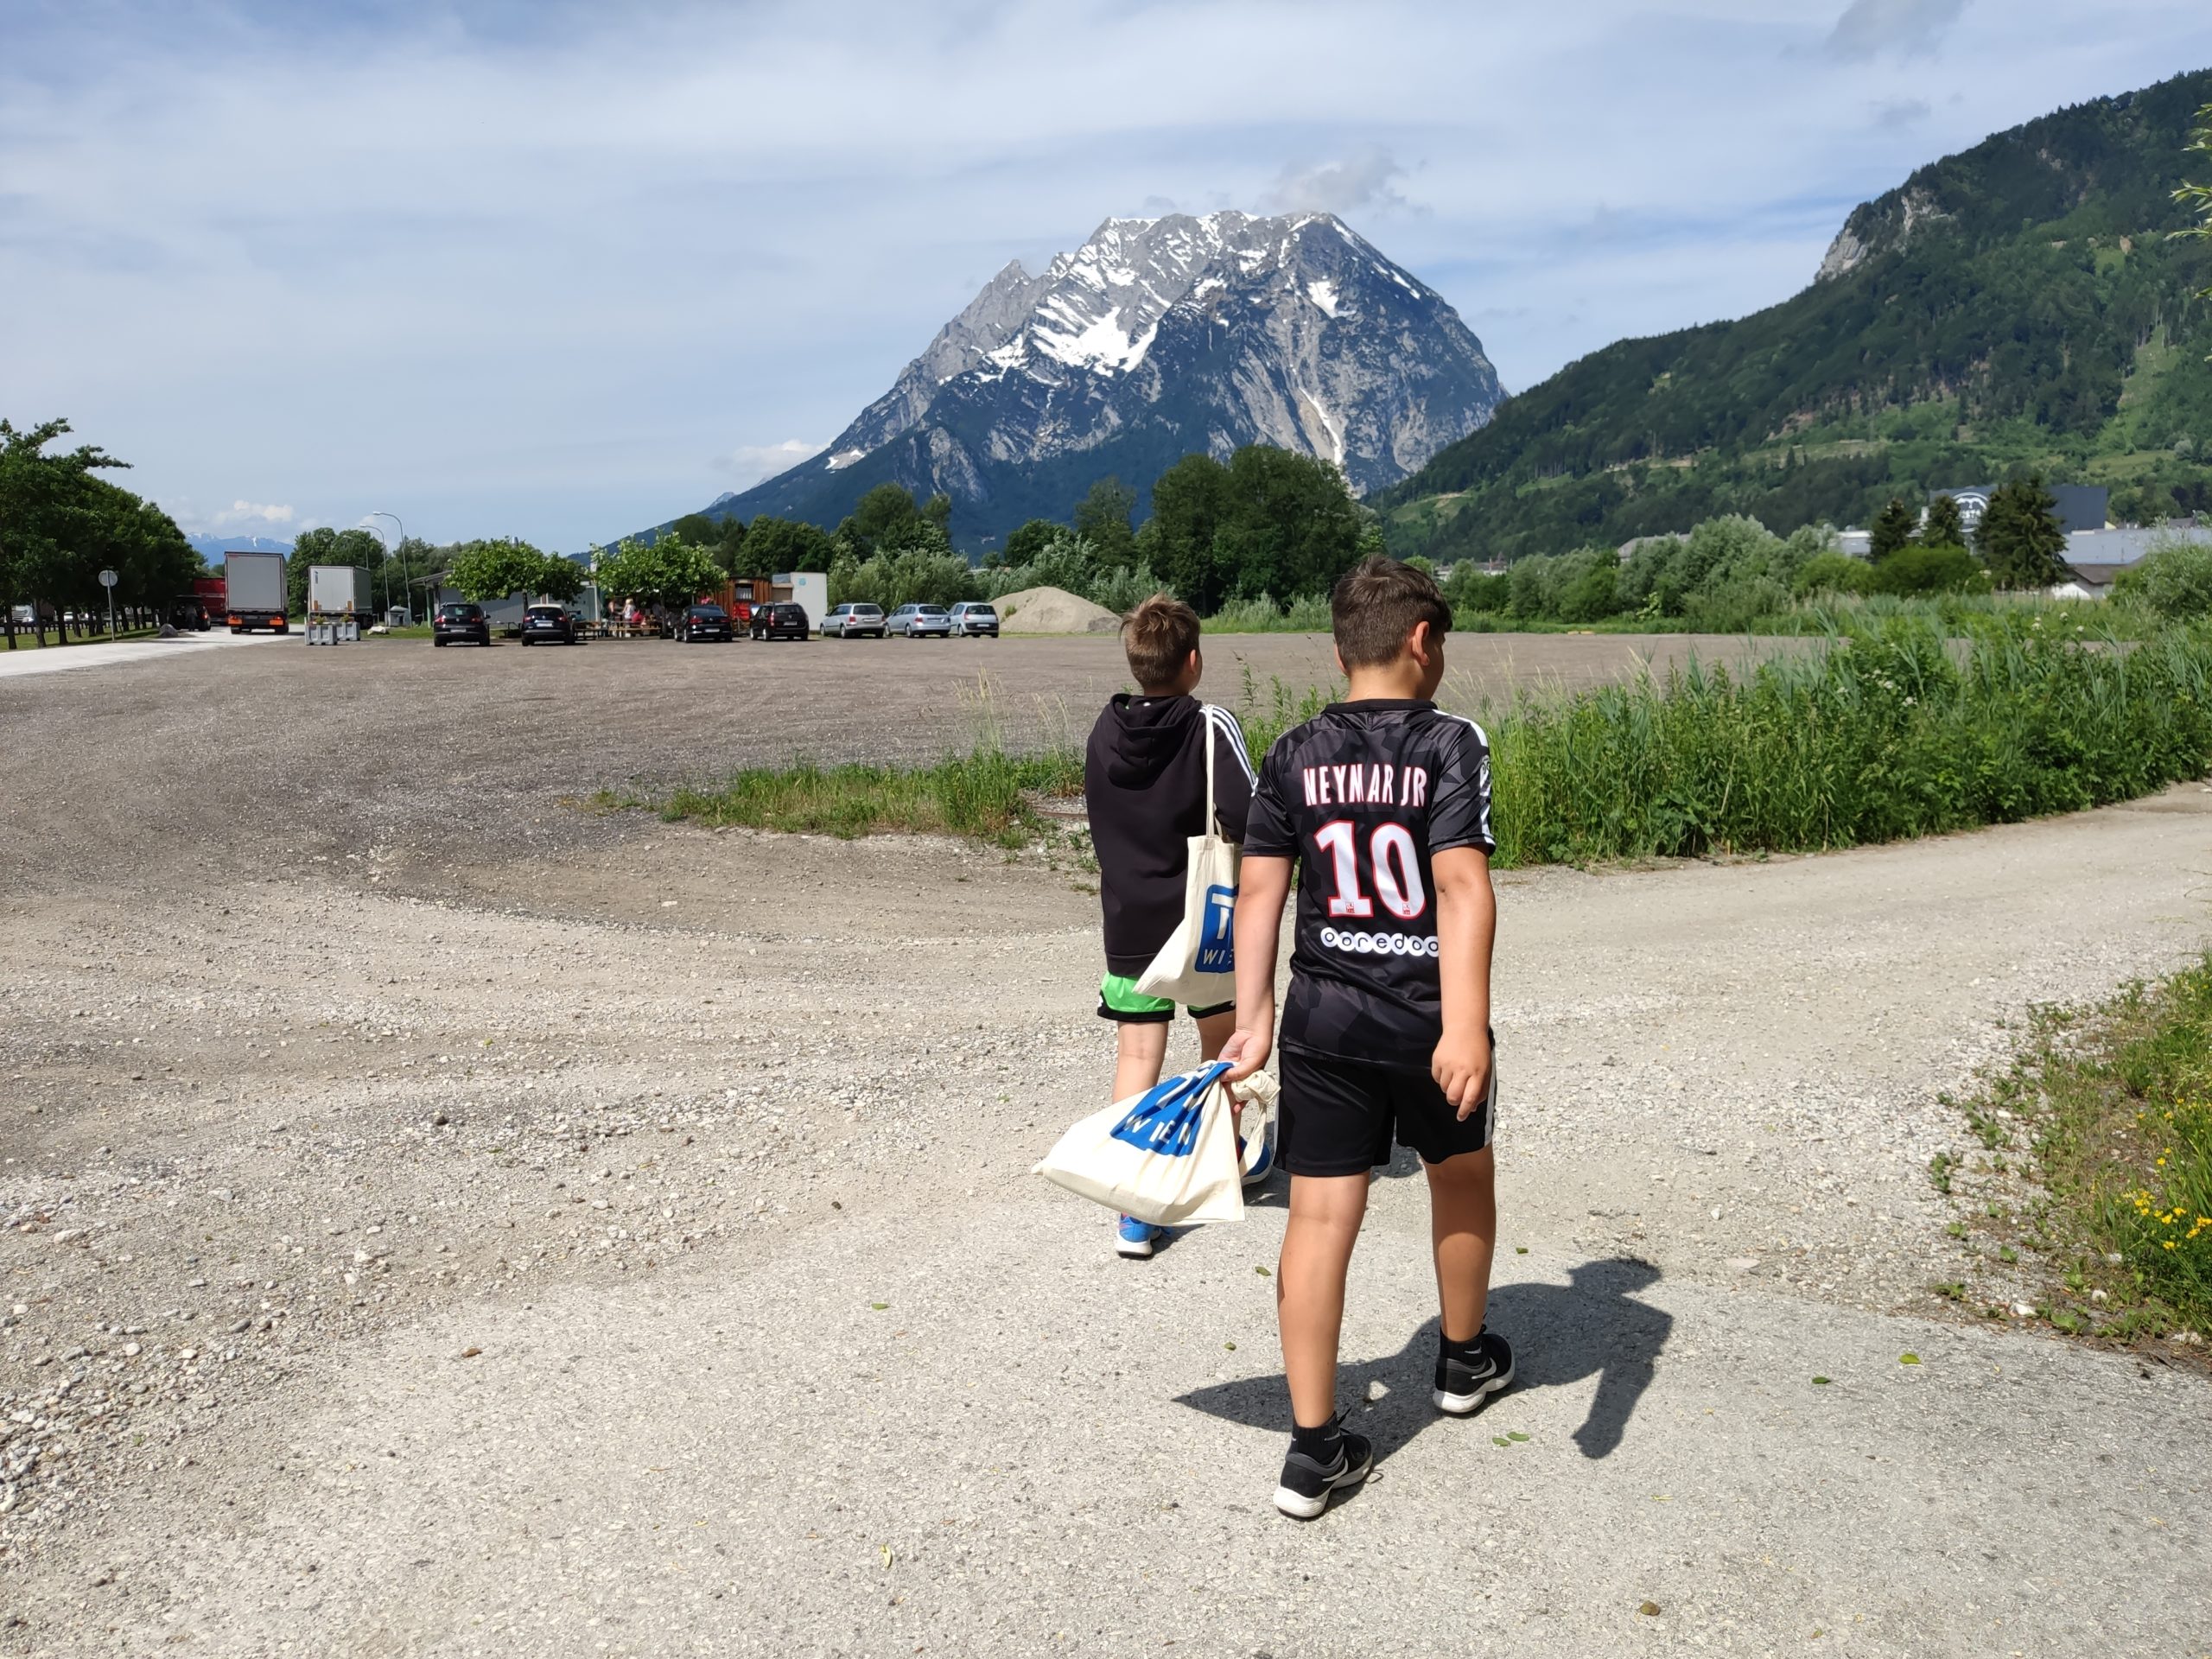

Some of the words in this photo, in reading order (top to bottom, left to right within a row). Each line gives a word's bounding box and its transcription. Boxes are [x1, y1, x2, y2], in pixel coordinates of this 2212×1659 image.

[1303, 763, 1394, 807] NEYMAR
[1400, 766, 1427, 807] JR
[1313, 820, 1427, 919] 10
[1322, 929, 1439, 955] ooredoo
